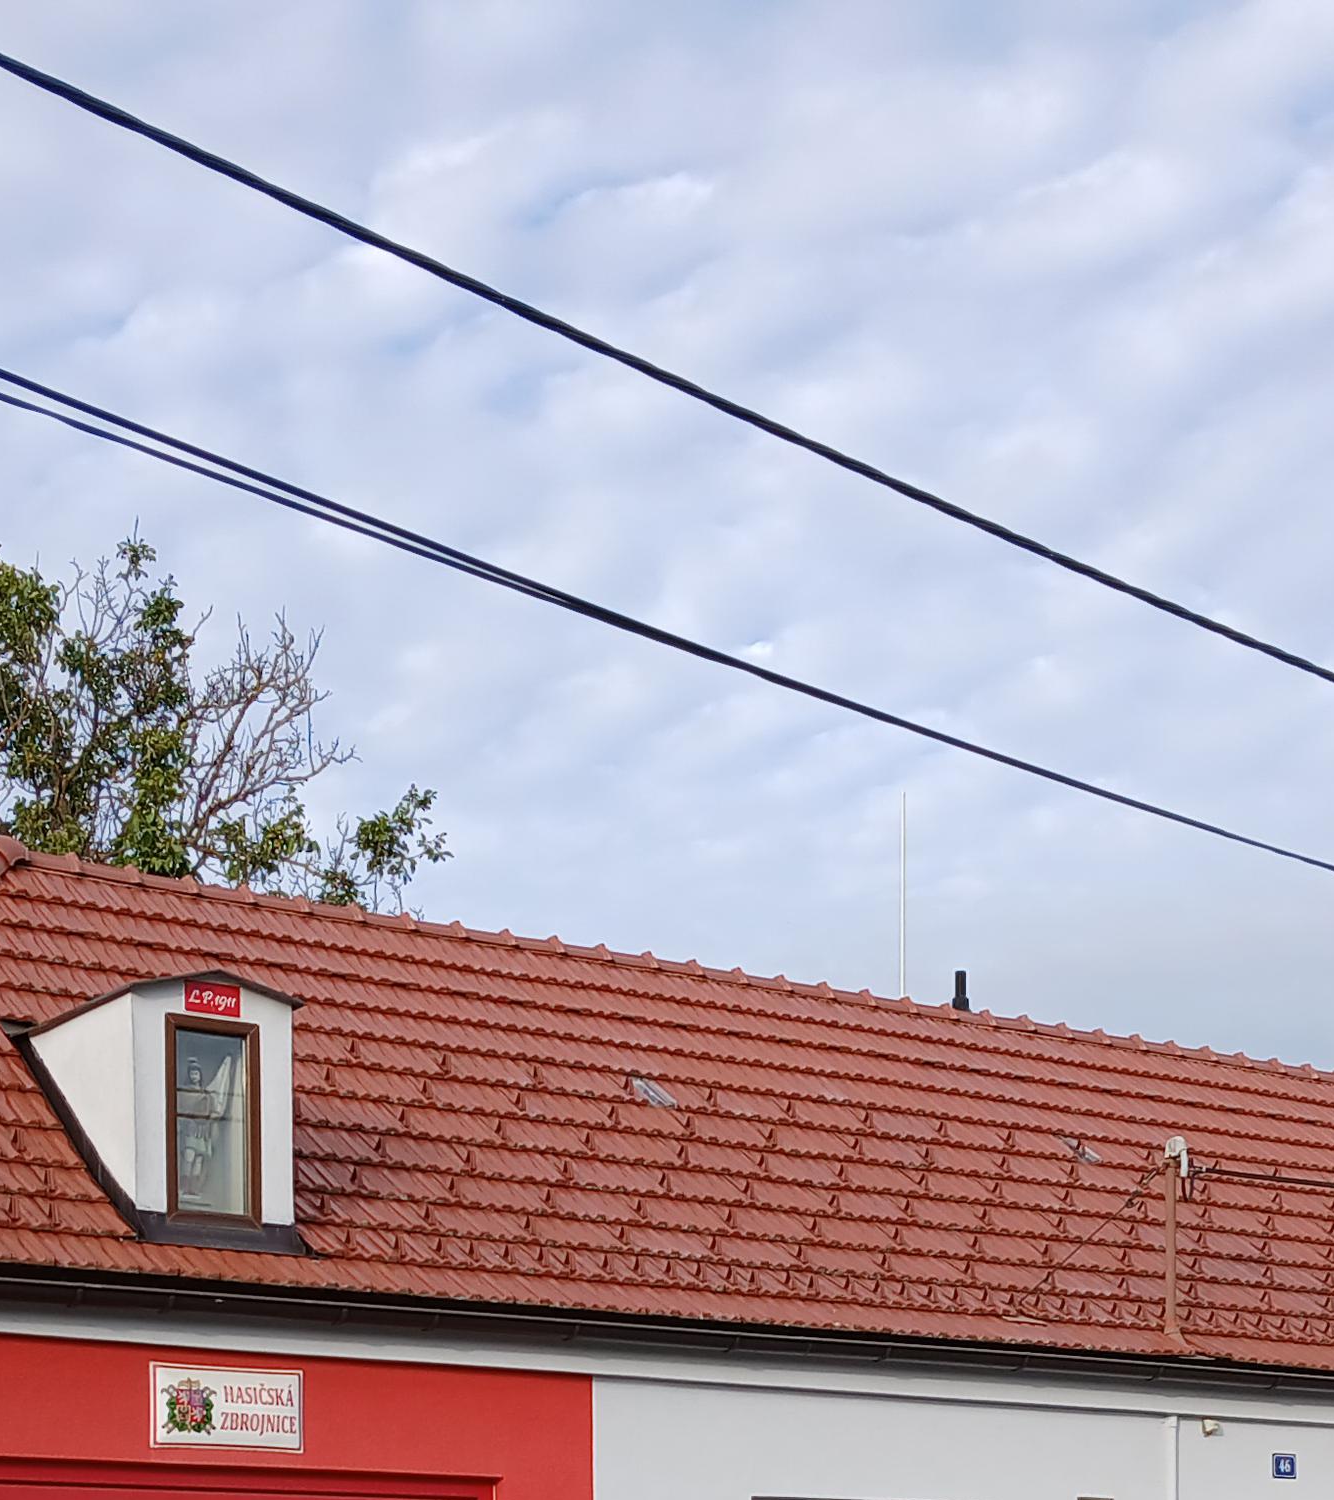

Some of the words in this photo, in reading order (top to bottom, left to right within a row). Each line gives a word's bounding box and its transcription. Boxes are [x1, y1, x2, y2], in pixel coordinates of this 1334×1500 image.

[223, 1382, 295, 1407] HASIČSKÁ
[220, 1411, 297, 1436] ZBROJNICE
[1278, 1459, 1291, 1473] 46
